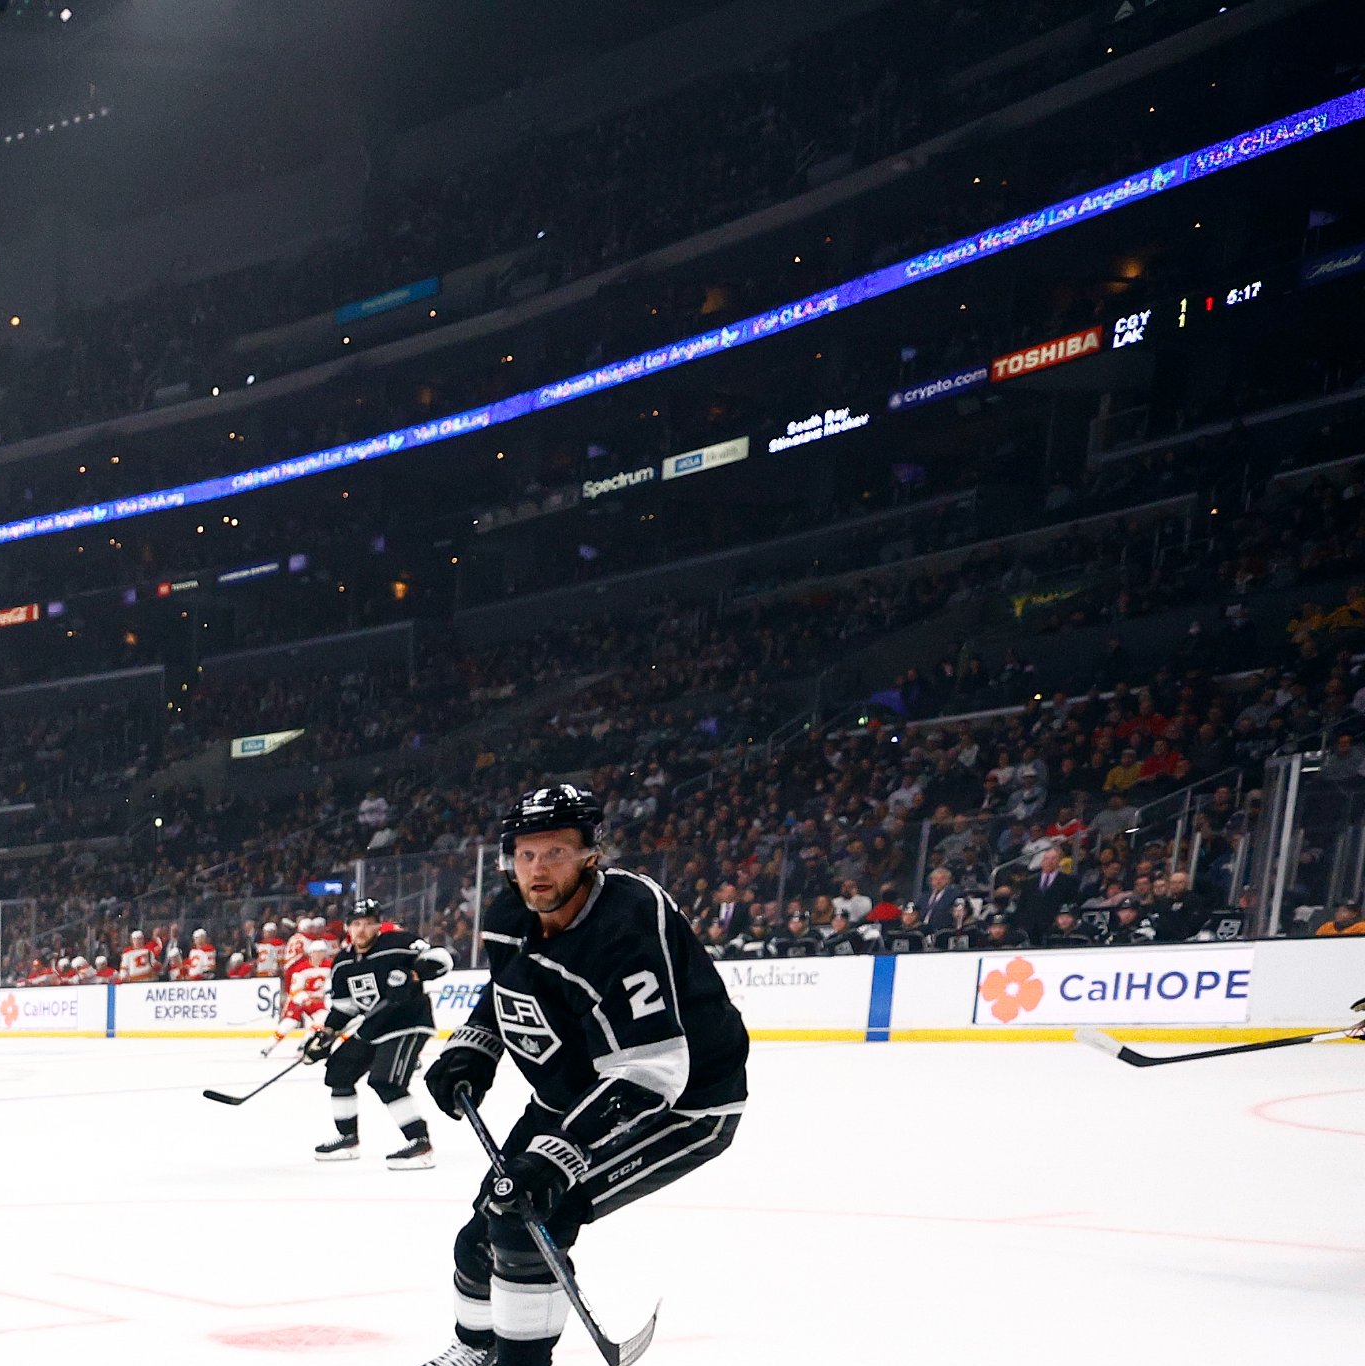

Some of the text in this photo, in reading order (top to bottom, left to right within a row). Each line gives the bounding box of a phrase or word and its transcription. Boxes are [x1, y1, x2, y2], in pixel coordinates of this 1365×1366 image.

[978, 210, 1047, 251] Hospital
[1047, 203, 1076, 227] Los
[1077, 176, 1149, 216] Angeles
[1115, 309, 1151, 333] CGY
[1113, 328, 1144, 349] LAK
[995, 331, 1099, 377] TOSHIBA
[904, 367, 987, 404] crypto.com
[787, 414, 822, 435] South
[583, 467, 654, 499] Spectrum
[731, 965, 819, 987] Medicine
[1059, 968, 1251, 1003] CalHOPE
[146, 986, 217, 1001] AMERICAN
[622, 970, 666, 1020] 2
[24, 1000, 77, 1018] CalHOPE
[154, 1003, 217, 1019] EXPRESS
[608, 1157, 643, 1183] CCM
